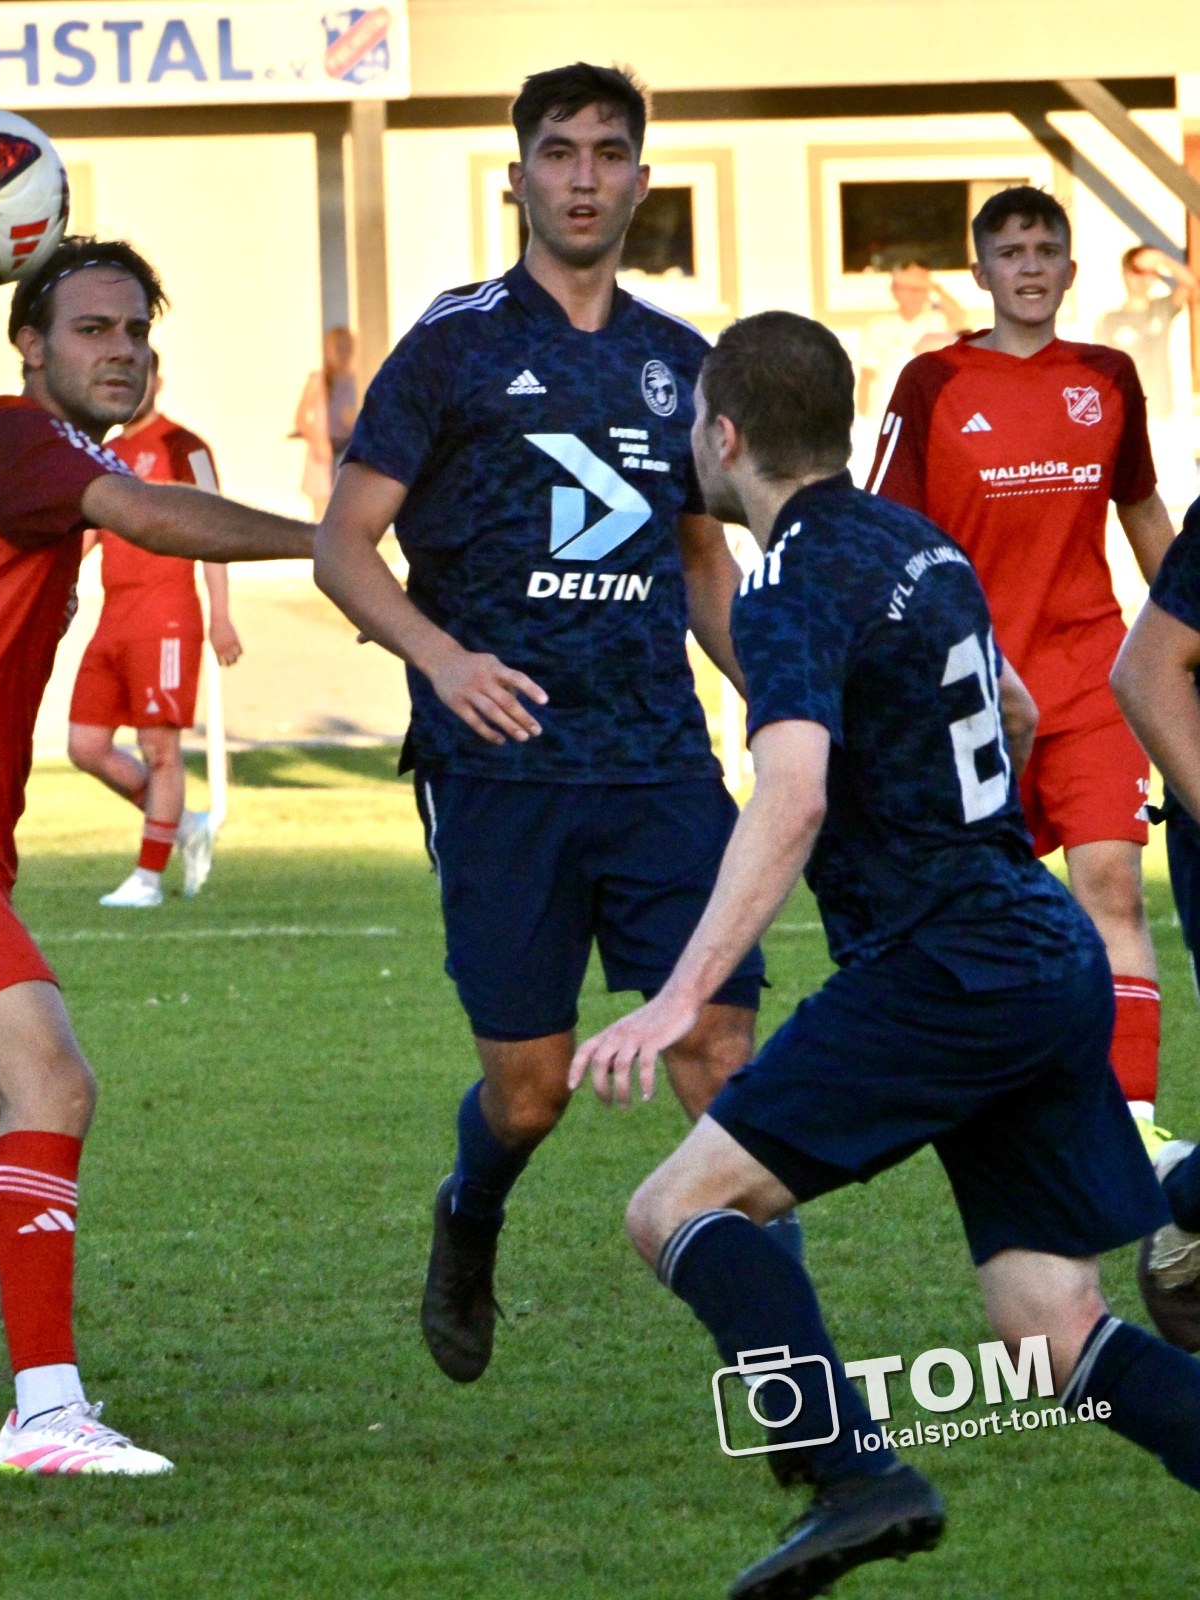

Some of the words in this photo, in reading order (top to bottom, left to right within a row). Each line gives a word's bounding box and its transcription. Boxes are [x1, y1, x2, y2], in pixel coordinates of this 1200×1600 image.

[526, 571, 653, 601] DELTIN
[887, 582, 914, 621] VFL
[941, 625, 1011, 824] 2
